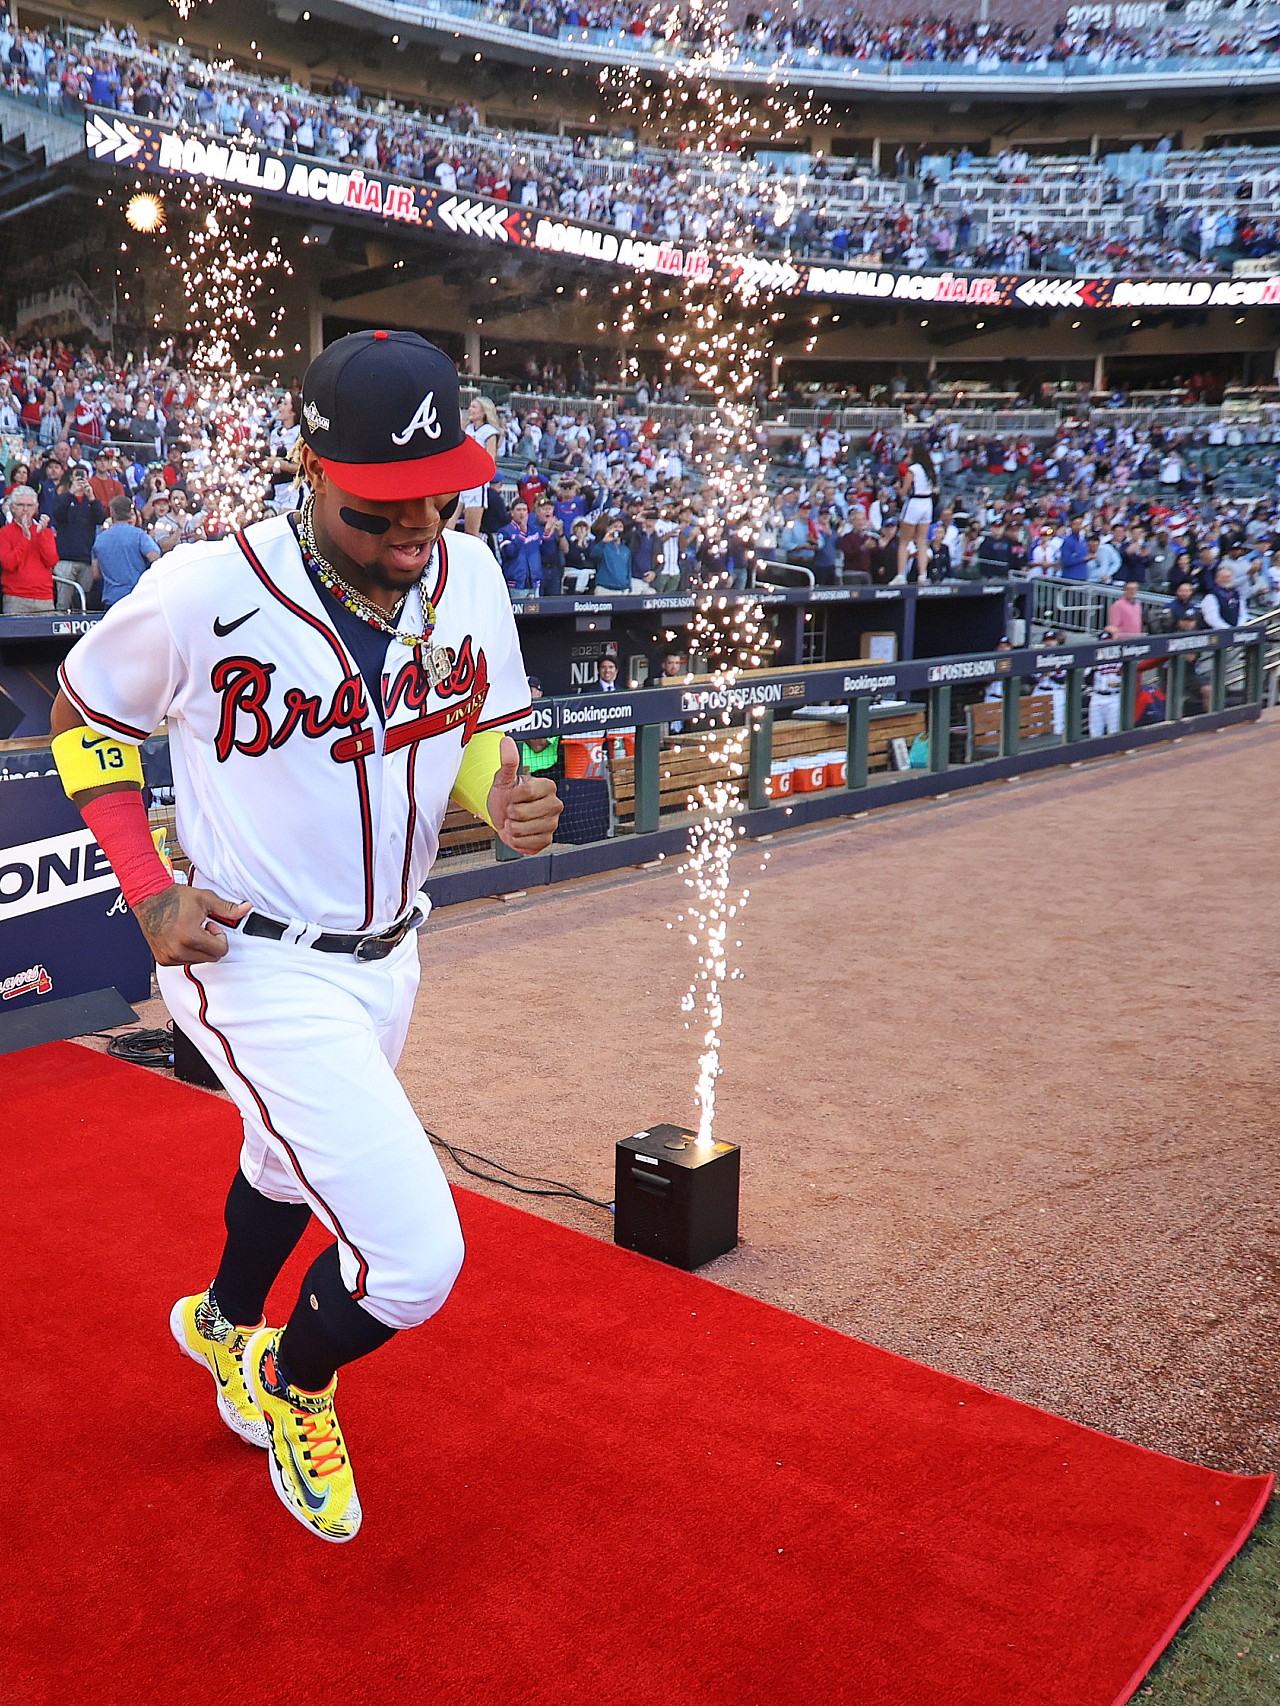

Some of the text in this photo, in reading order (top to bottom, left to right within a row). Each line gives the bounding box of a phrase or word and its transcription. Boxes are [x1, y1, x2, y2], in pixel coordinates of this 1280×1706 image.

[159, 133, 420, 220] RONALD ACUÑA JR.
[535, 219, 713, 284] RONALD ACUÑA JR.
[807, 267, 1001, 305] RONALD ACUÑA JR.
[391, 391, 442, 446] A
[574, 602, 613, 612] Booking.com
[652, 598, 695, 608] POSTSEASON
[939, 659, 996, 681] POSTSEASON
[843, 674, 896, 692] Booking.com
[700, 683, 782, 709] POSTSEASON
[509, 705, 632, 733] DS Booking.com
[95, 747, 124, 771] 13
[779, 774, 790, 791] G
[812, 768, 823, 786] G
